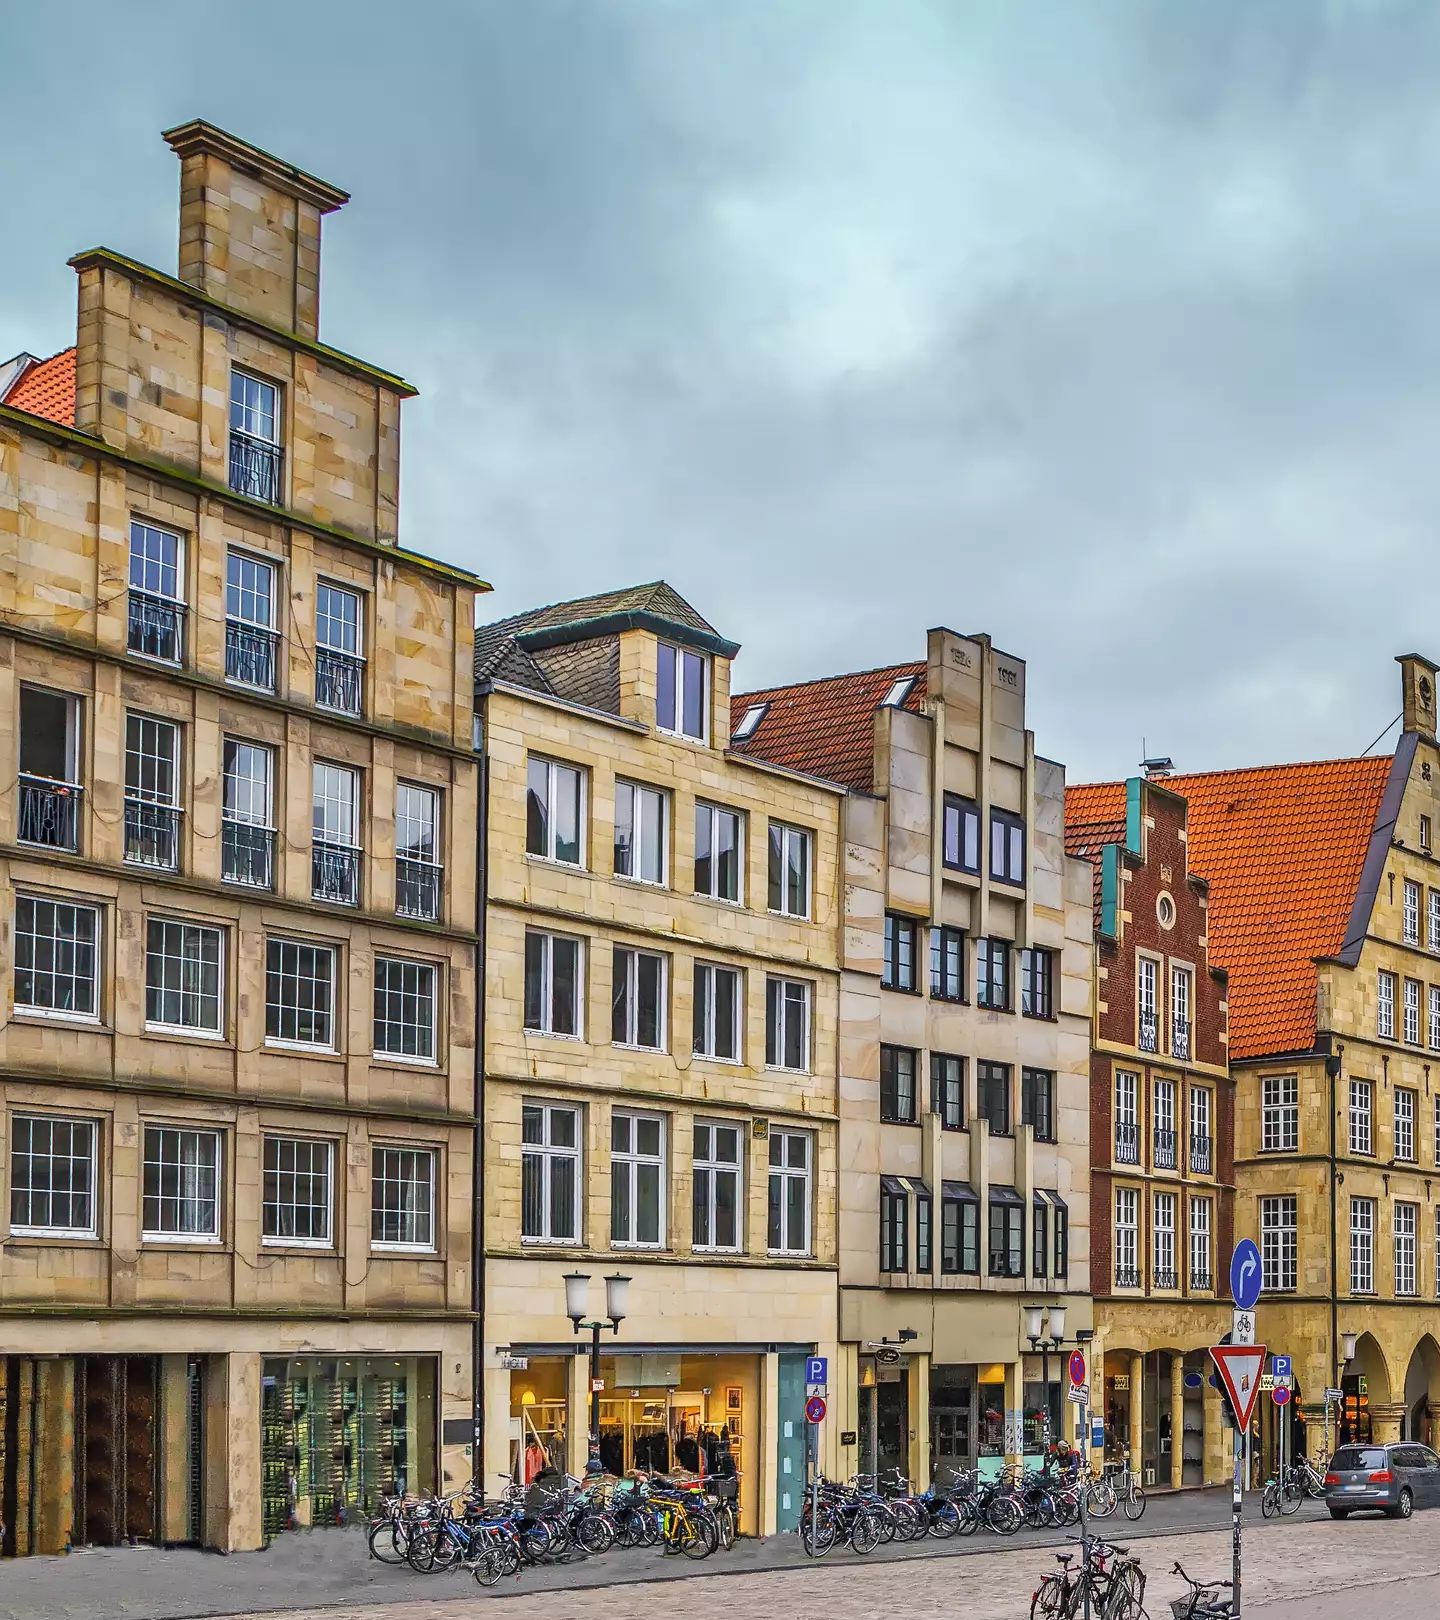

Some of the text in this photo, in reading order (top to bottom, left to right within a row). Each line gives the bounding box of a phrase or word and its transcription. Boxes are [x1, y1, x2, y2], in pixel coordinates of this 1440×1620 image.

[1239, 1333, 1249, 1343] frei
[811, 1361, 822, 1380] P
[1276, 1359, 1287, 1374] P
